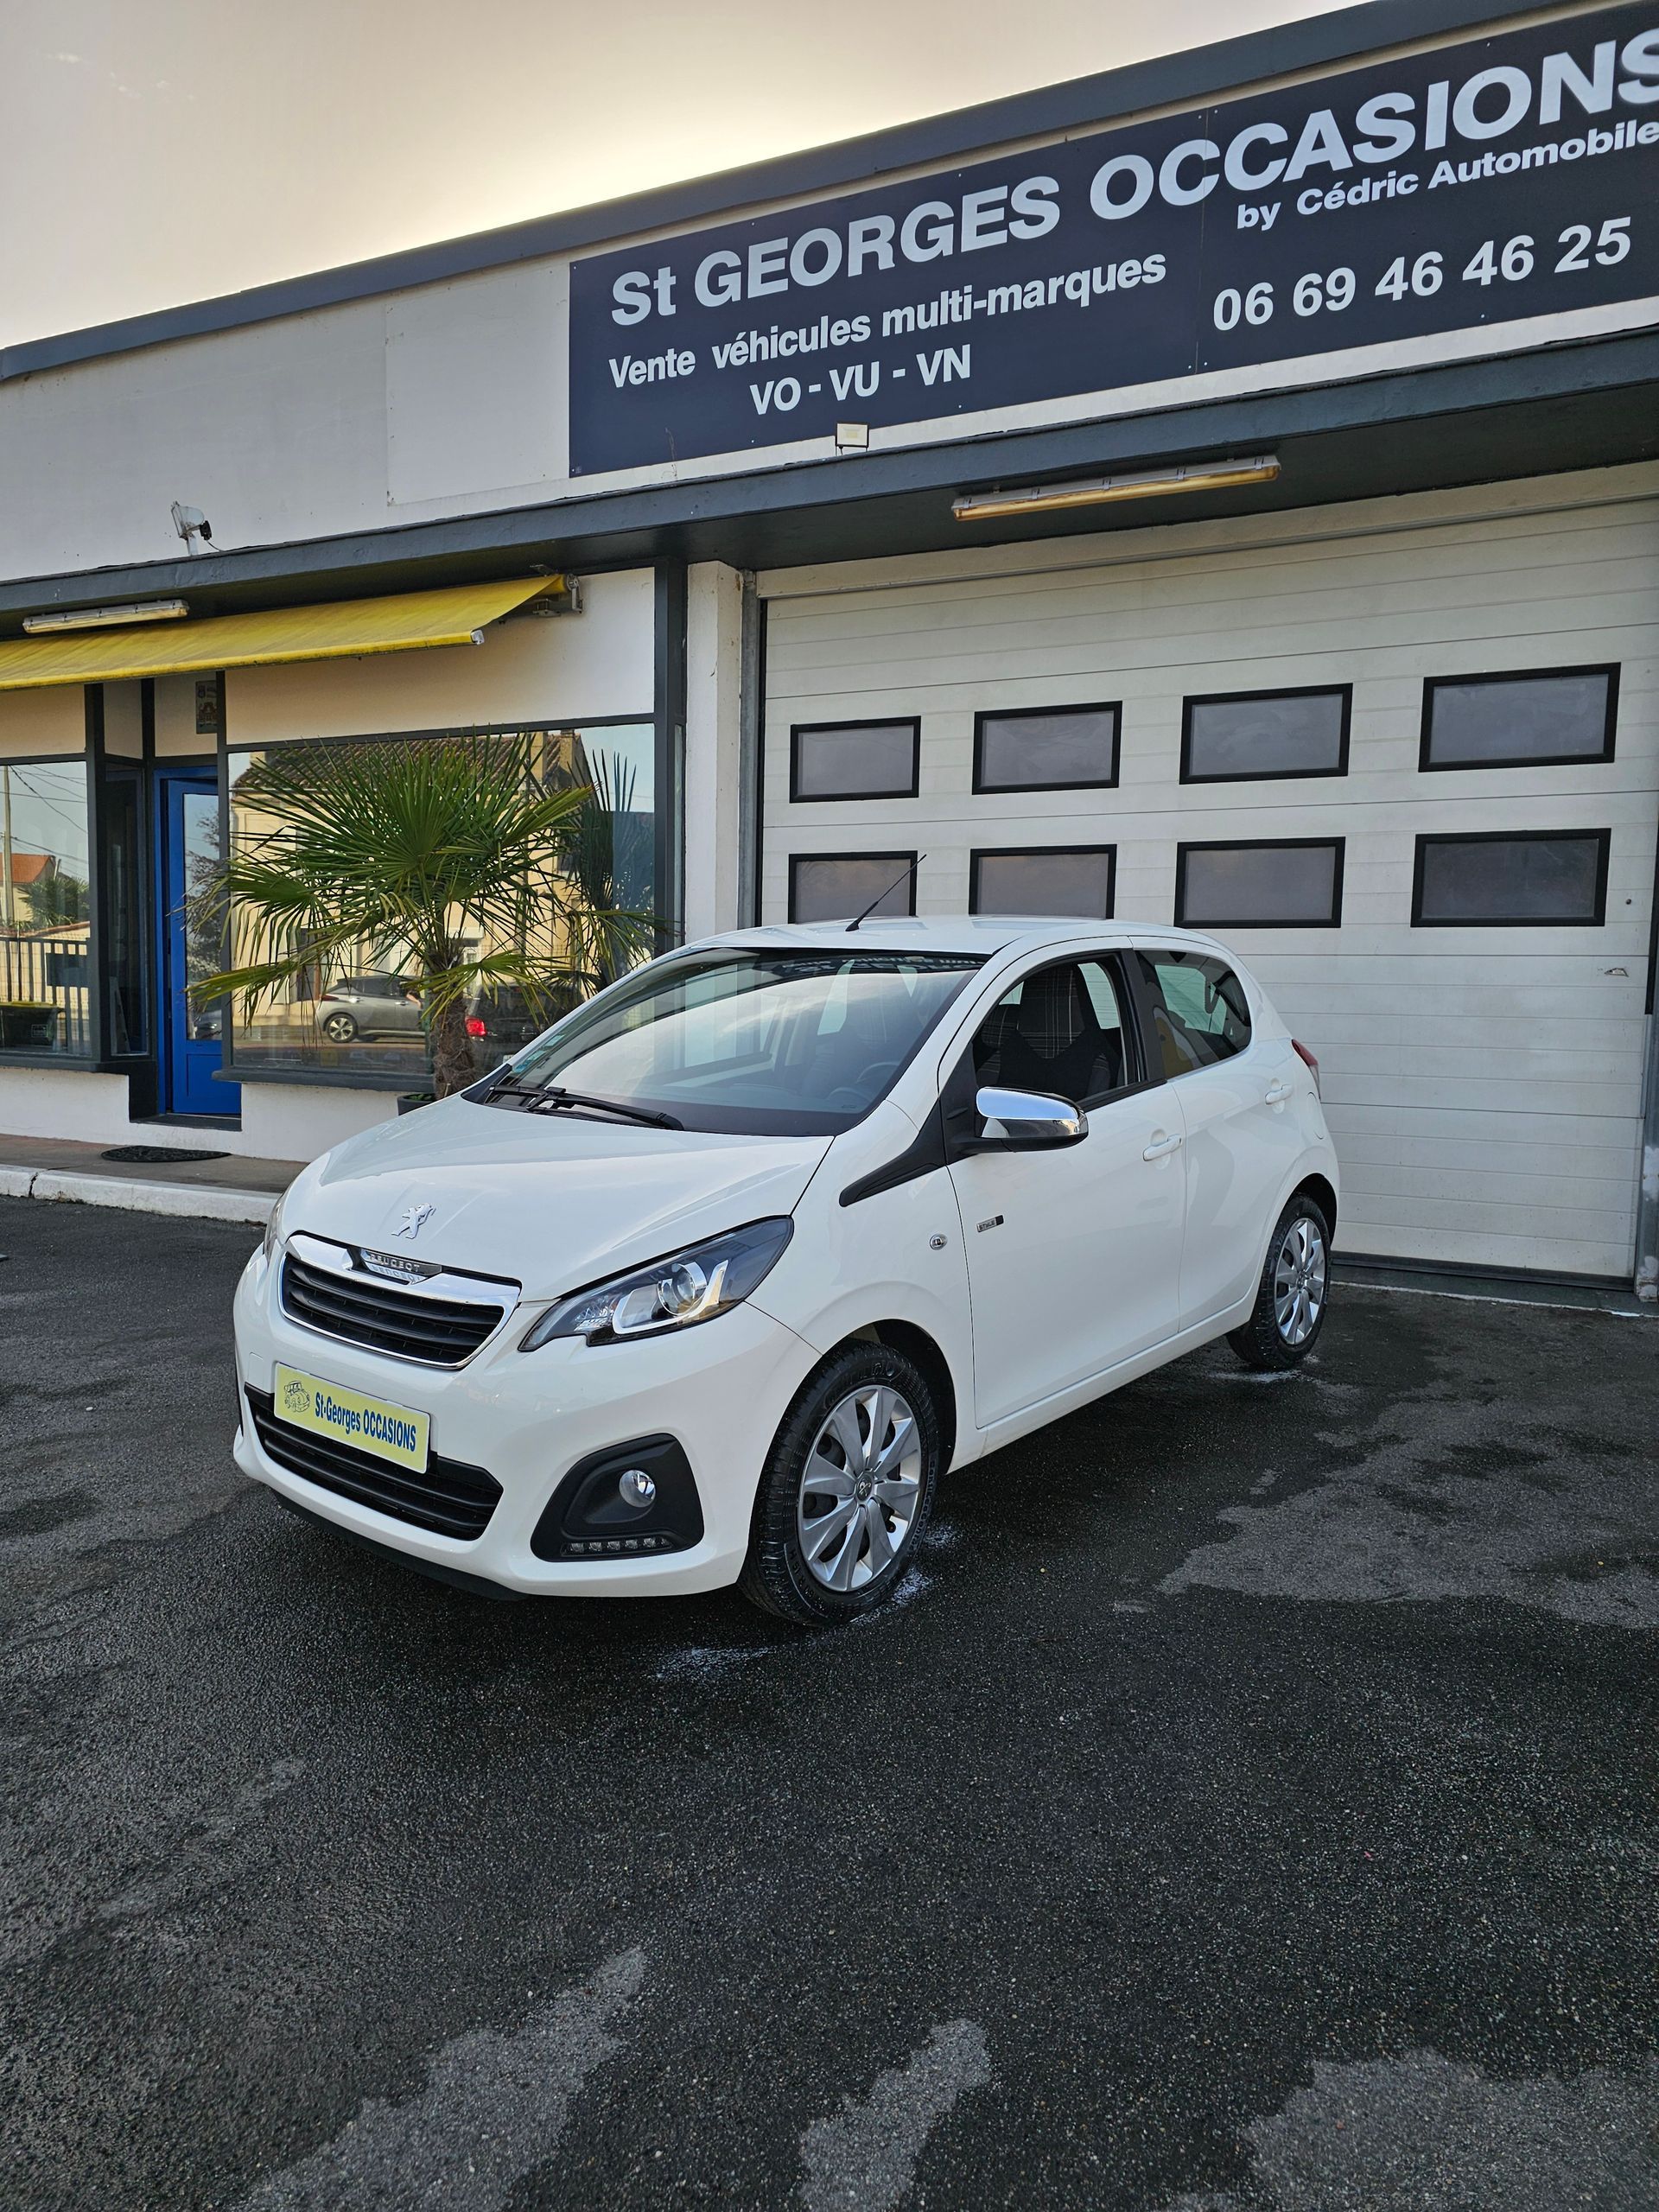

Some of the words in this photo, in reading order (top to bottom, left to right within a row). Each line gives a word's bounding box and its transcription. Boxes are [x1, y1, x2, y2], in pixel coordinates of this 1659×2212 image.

[611, 266, 677, 326] St
[694, 175, 1060, 308] GEORGES
[1090, 27, 1659, 220] OCCASIONS
[1236, 201, 1281, 232] by
[1296, 171, 1419, 215] Cédric
[1427, 119, 1659, 189] Automobile
[608, 347, 696, 388] Vente
[711, 315, 871, 370] véhicules
[882, 253, 1166, 337] multi-marques
[1213, 282, 1274, 331] 06
[1293, 267, 1356, 317] 69
[1375, 251, 1444, 302] 46
[1462, 234, 1535, 286] 46
[1554, 216, 1631, 273] 25
[749, 377, 802, 416] VO
[829, 360, 880, 402] VU
[916, 343, 970, 386] VN
[369, 1253, 420, 1273] PEUGEOT
[315, 1391, 361, 1435] St-Georges
[363, 1408, 416, 1452] OCCASIONS
